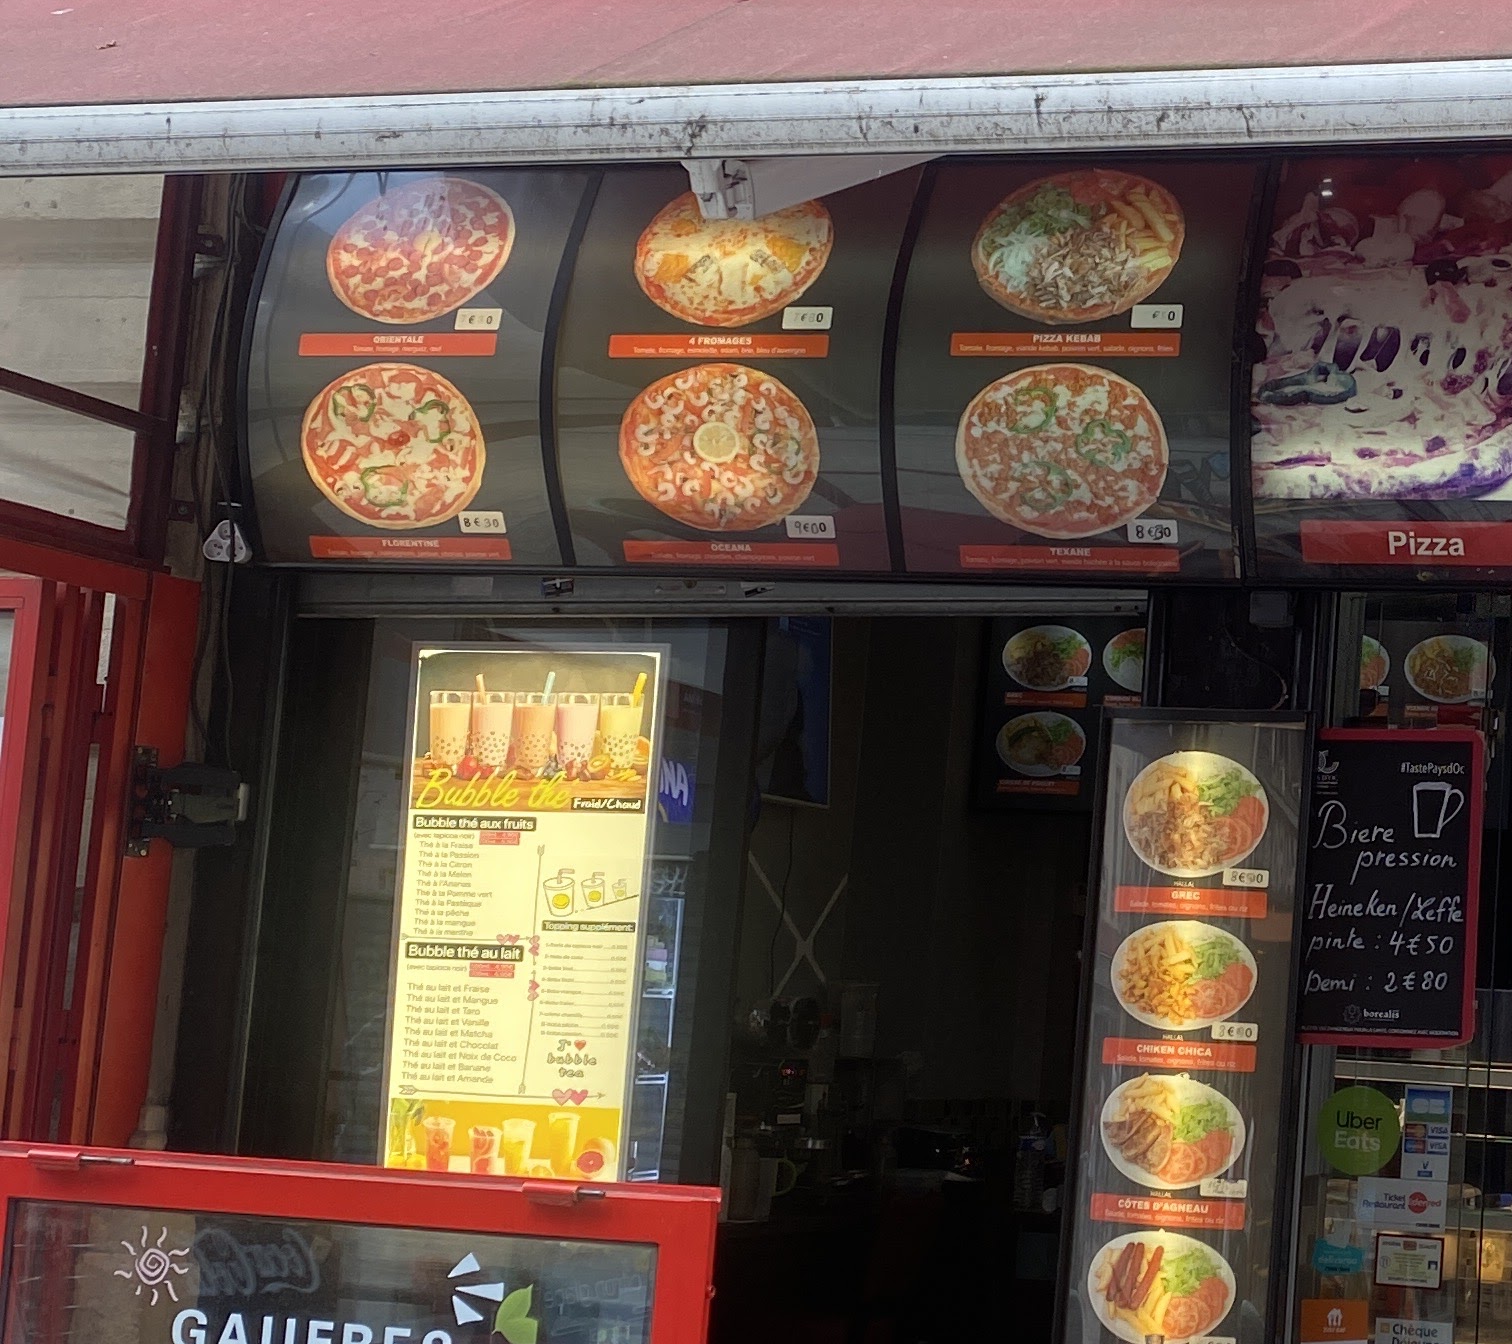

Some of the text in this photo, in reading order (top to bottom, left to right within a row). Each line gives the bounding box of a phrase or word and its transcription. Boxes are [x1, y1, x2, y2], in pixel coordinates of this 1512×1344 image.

[373, 335, 424, 344] ORIENTALE
[688, 336, 752, 346] 4 FROMAGES
[1032, 333, 1101, 343] PIZZA KEBAB
[381, 539, 440, 548] FLORENTINE
[710, 543, 752, 552] OCEANA
[1388, 531, 1465, 557] Pizza
[1050, 547, 1091, 557] TEXANE
[1401, 761, 1466, 776] #TastePaysdOc
[416, 767, 521, 809] Bubble
[572, 797, 642, 810] Froid/Chaud
[415, 816, 534, 830] Bubble thé aux fruits
[1312, 800, 1395, 849] Biere
[1350, 850, 1458, 886] pression
[1171, 890, 1201, 901] GREC
[1306, 926, 1366, 960] pinte
[408, 944, 520, 960] Bubble thé au lait
[407, 982, 424, 991] Thé
[463, 984, 490, 993] Fraise
[462, 996, 498, 1005] Mangue
[462, 1006, 481, 1016] Taro
[1363, 1008, 1400, 1020] borealis
[1136, 1044, 1213, 1057] CHIKEN CHICA
[493, 1053, 517, 1062] Coco
[546, 1052, 598, 1066] bubble
[558, 1067, 585, 1078] tea
[1336, 1110, 1383, 1131] Uber
[1430, 1126, 1449, 1135] VISA
[1334, 1130, 1382, 1153] Eats
[1429, 1142, 1448, 1151] VISA
[1383, 1192, 1406, 1203] Ticket
[1117, 1197, 1209, 1214] CÔTES D'AGNEAU
[1392, 1323, 1438, 1339] Chèque
